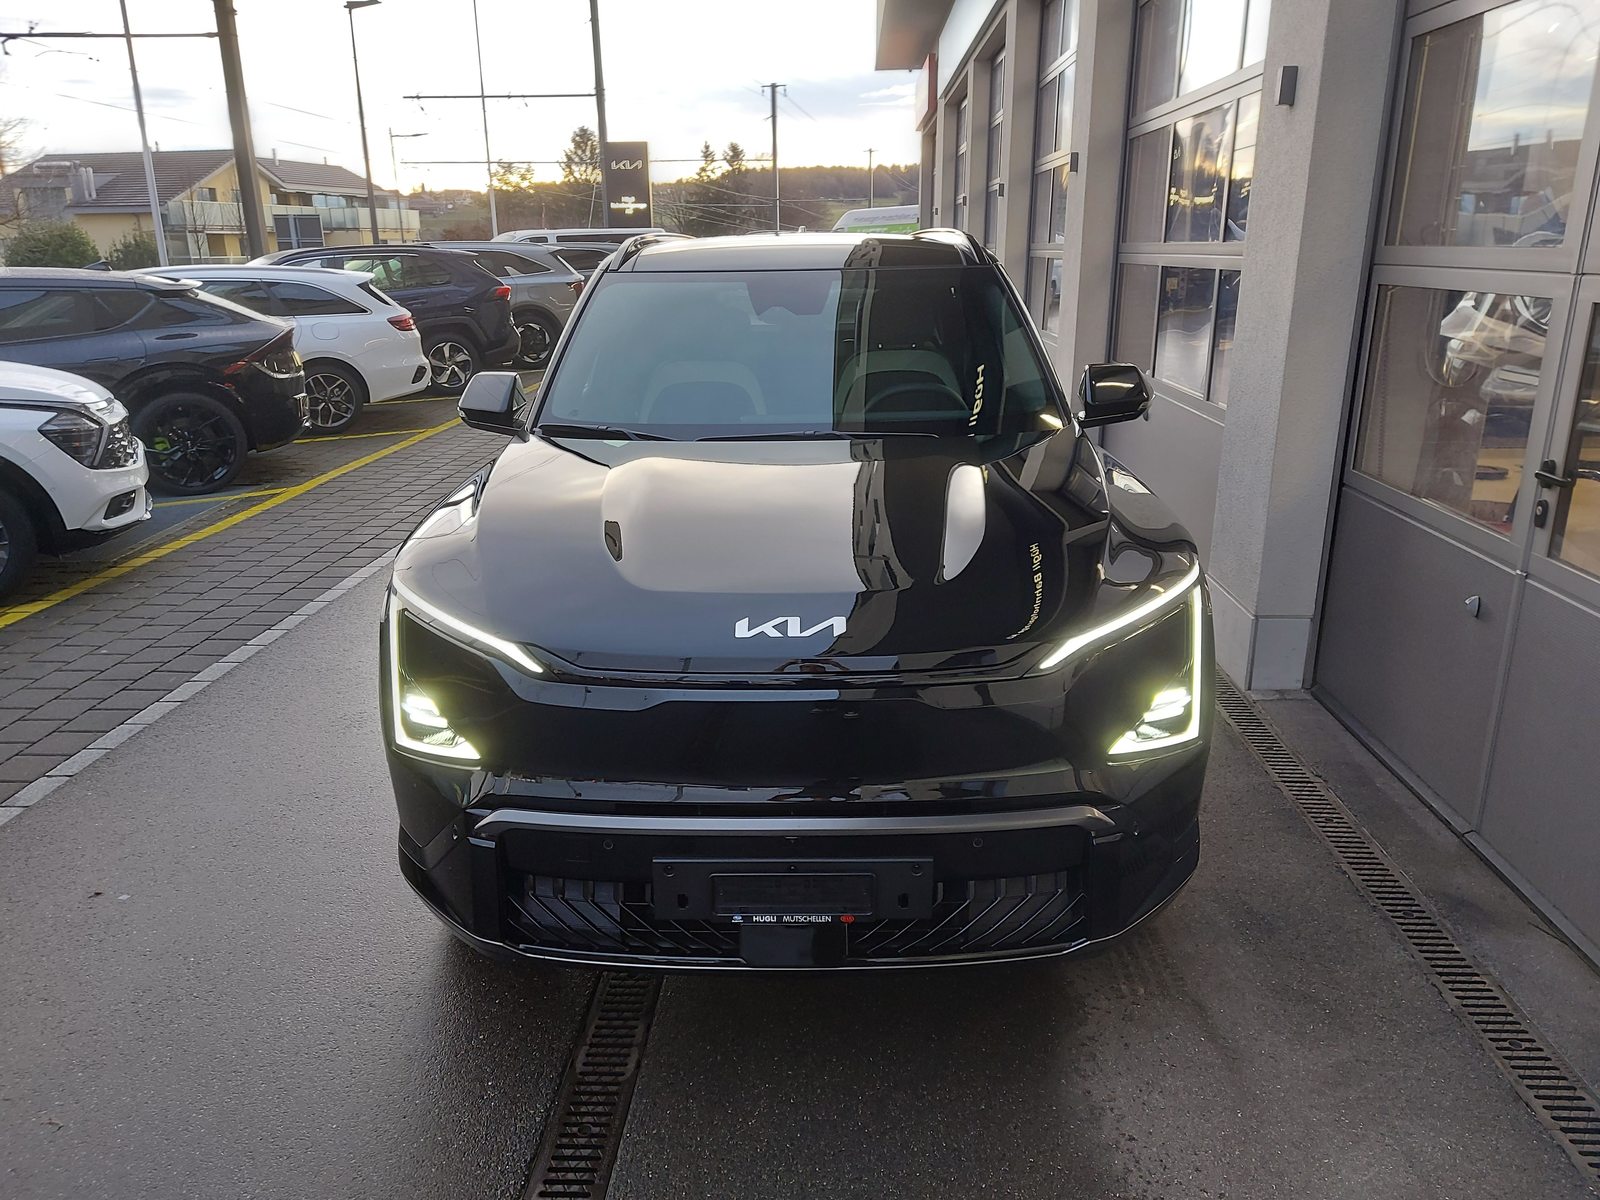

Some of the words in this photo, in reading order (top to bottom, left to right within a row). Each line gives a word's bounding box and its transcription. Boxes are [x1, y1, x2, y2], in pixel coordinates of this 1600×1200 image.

[611, 160, 643, 170] KIA
[735, 616, 847, 638] KIA
[782, 915, 832, 923] MUTSCHELLEN
